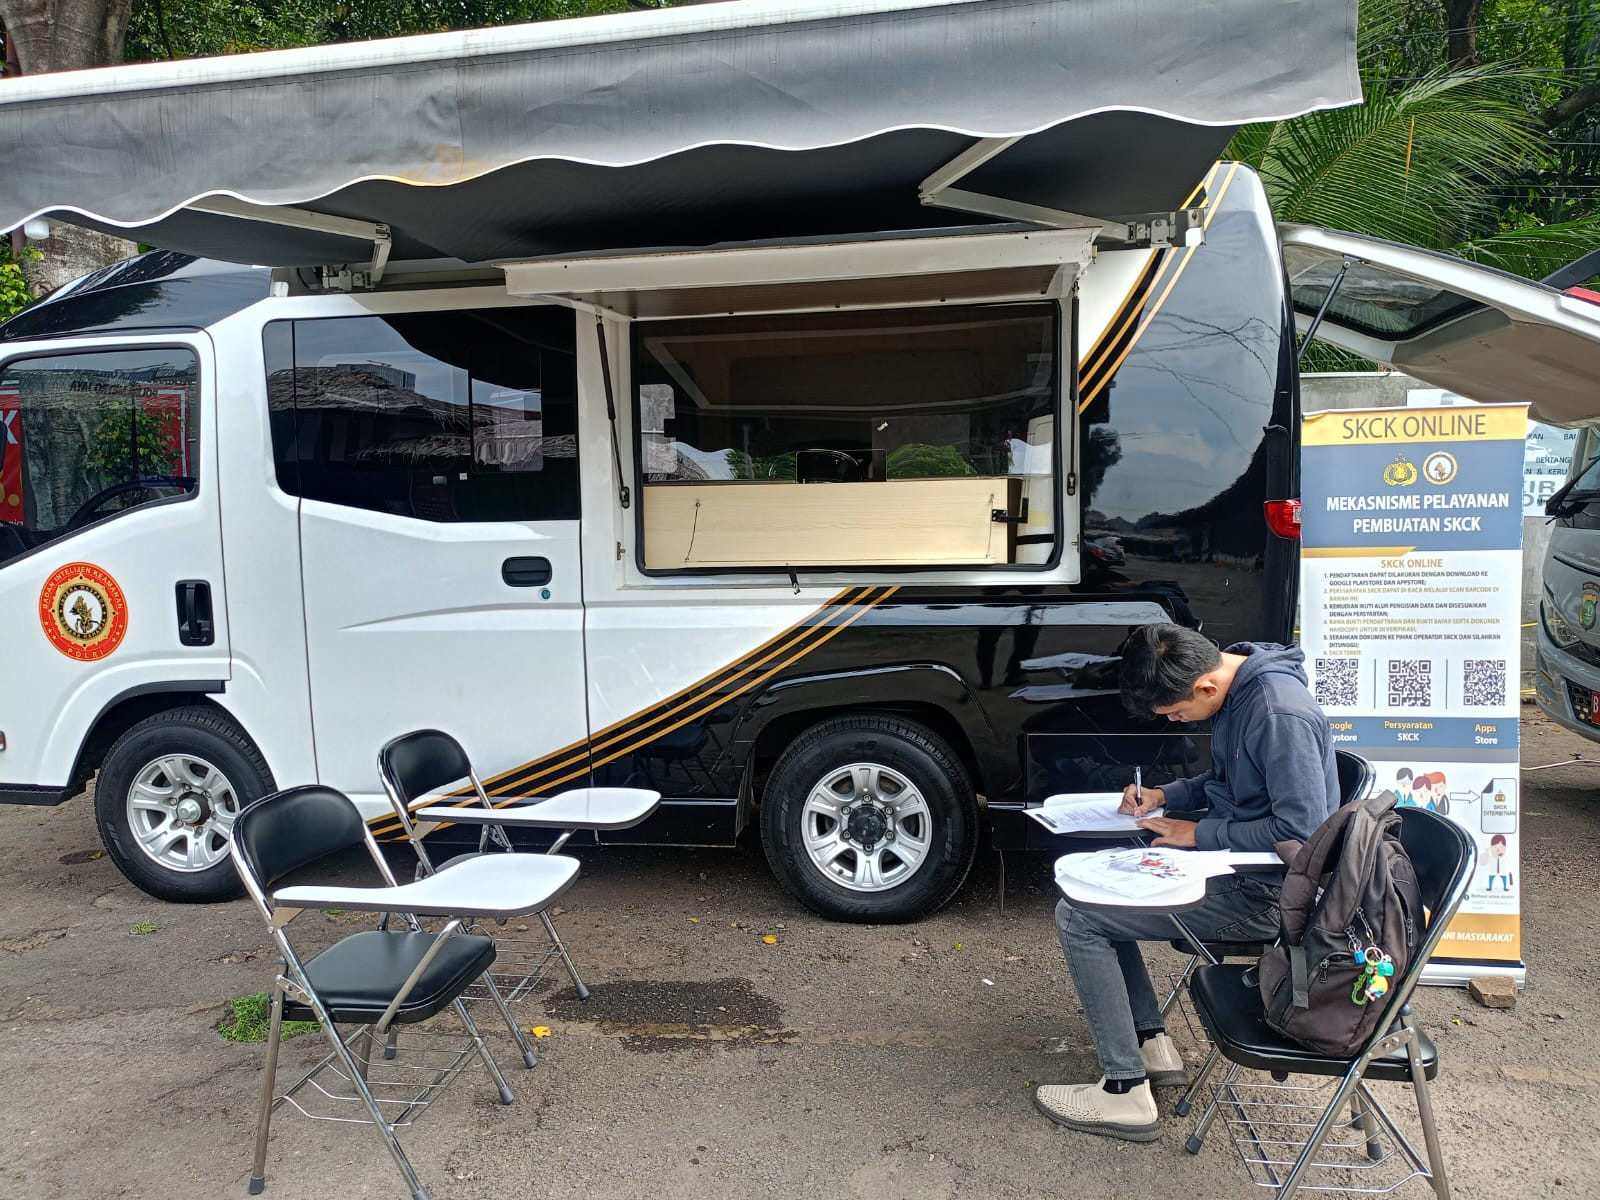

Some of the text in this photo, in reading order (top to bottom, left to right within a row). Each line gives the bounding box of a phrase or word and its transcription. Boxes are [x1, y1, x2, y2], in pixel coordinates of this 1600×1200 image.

[1342, 414, 1486, 439] SKCK ONLINE
[1327, 492, 1509, 511] MEKASNISME PELAYANAN
[1353, 517, 1481, 533] PEMBUATAN SKCK
[1381, 559, 1443, 568] SKCK ONLINE
[43, 567, 124, 609] BADAN INTELIJEN KEAMANAN
[68, 647, 104, 659] POLRI
[1384, 720, 1432, 732] Persyaratan
[1474, 724, 1497, 733] Apps
[1397, 733, 1419, 742] SKCK
[1474, 736, 1498, 745] Store
[1456, 932, 1515, 943] MASYARAKAT
